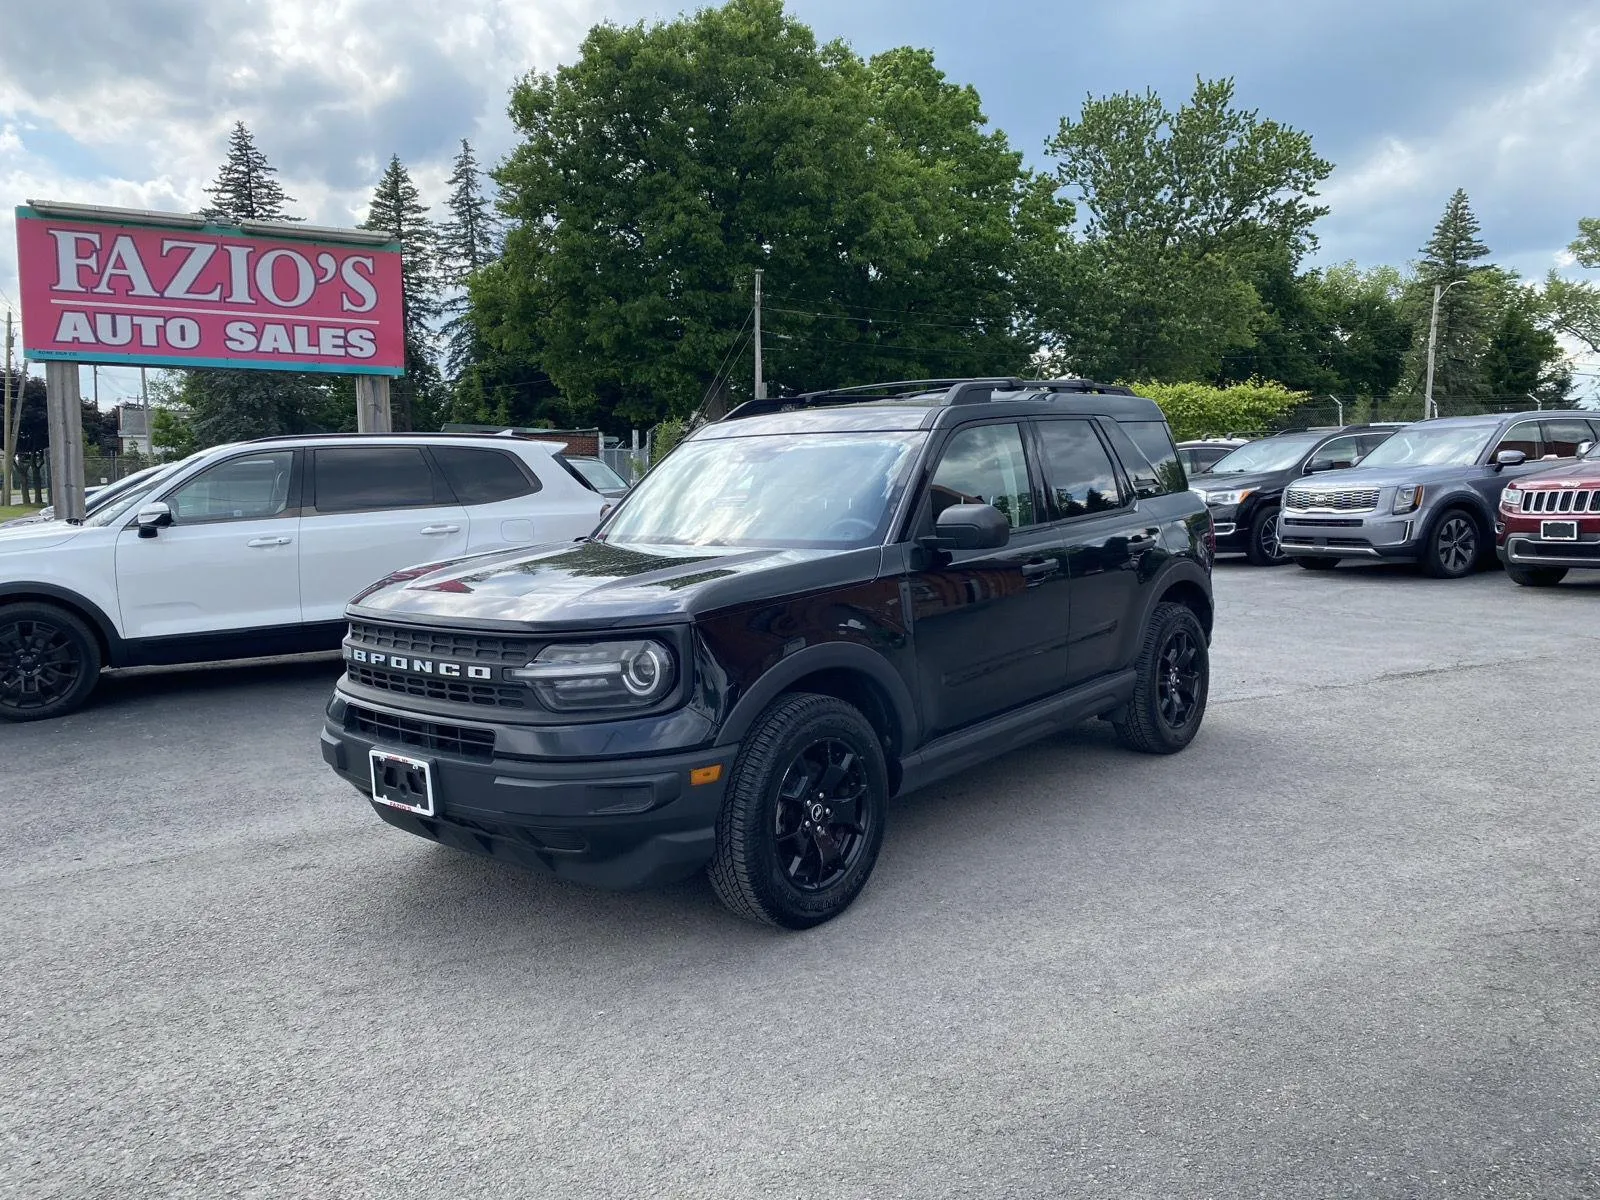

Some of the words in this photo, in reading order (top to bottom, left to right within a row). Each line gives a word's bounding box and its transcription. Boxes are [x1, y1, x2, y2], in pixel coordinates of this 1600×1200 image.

[47, 229, 379, 313] FAZIO'S
[54, 310, 201, 350] AUTO
[224, 320, 377, 359] SALES
[353, 649, 491, 679] BRONCO
